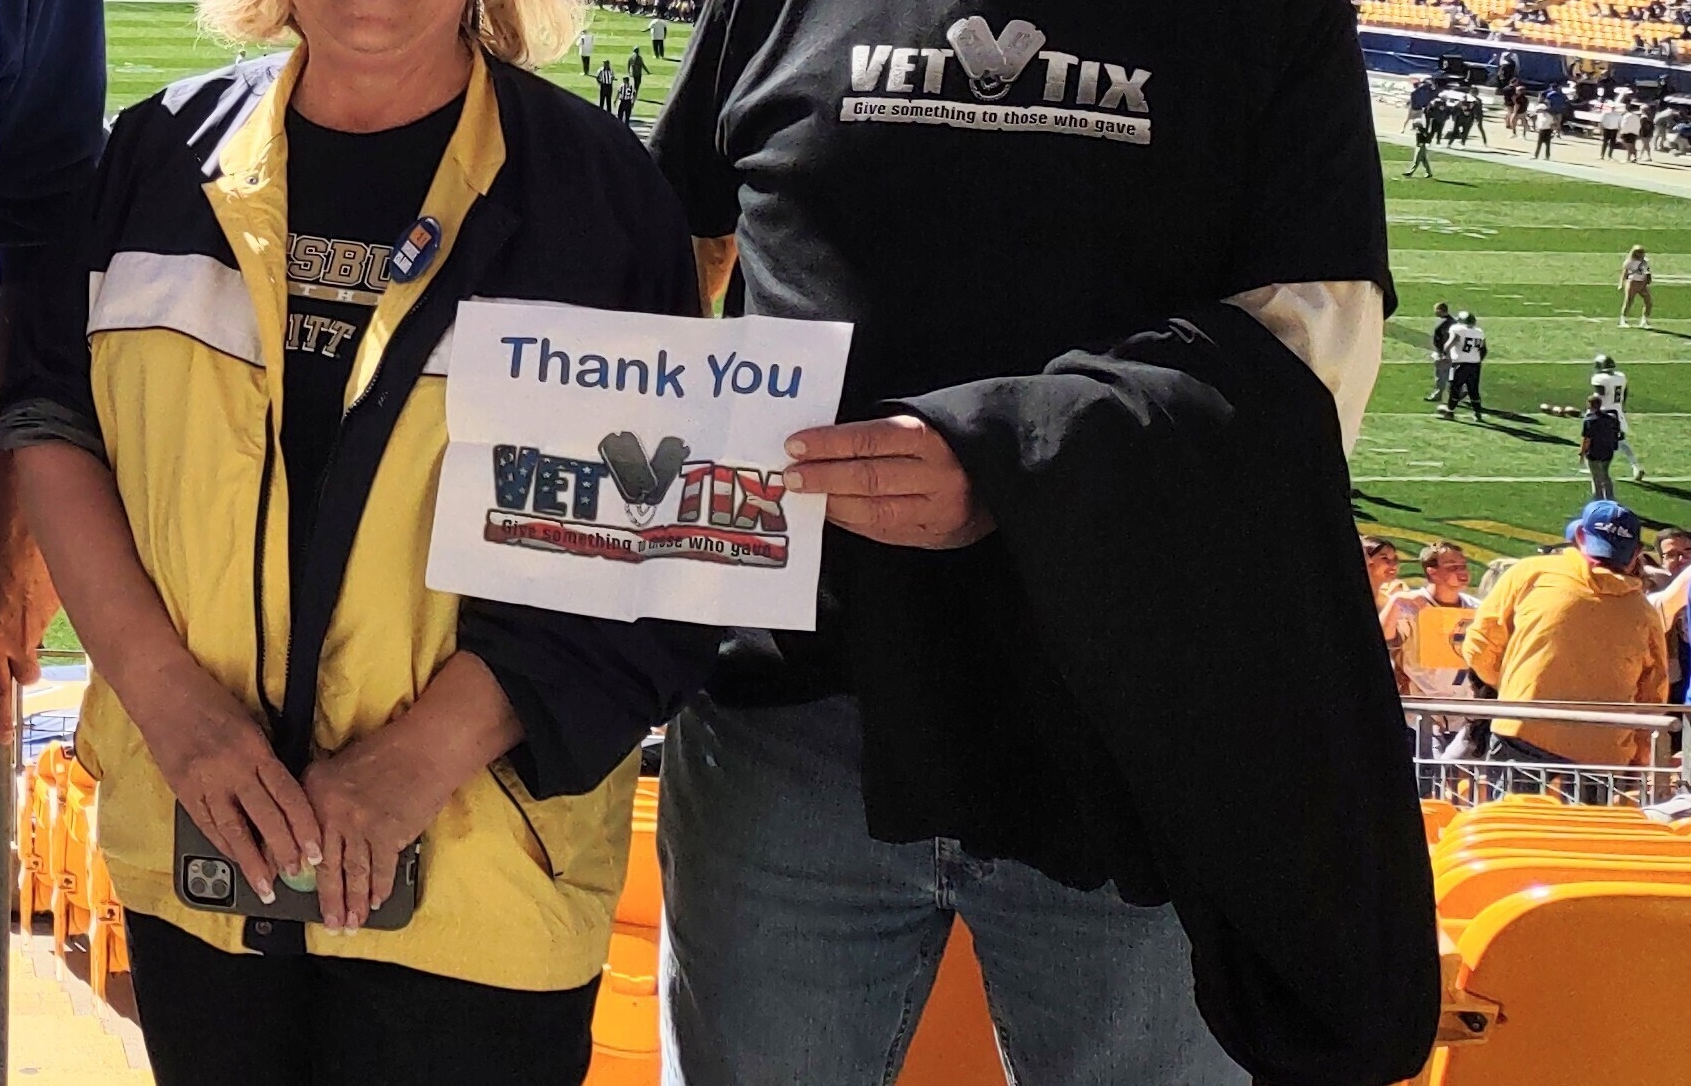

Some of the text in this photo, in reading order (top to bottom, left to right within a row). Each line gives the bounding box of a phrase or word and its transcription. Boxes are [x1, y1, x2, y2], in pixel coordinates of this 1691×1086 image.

[851, 44, 1152, 113] VET TIX
[853, 101, 1137, 136] Give something to those who gave
[285, 313, 357, 358] ITT
[499, 336, 803, 399] Thank You
[492, 444, 789, 533] VET TIX
[500, 519, 537, 538] Give
[543, 522, 633, 553] something
[687, 536, 725, 554] who
